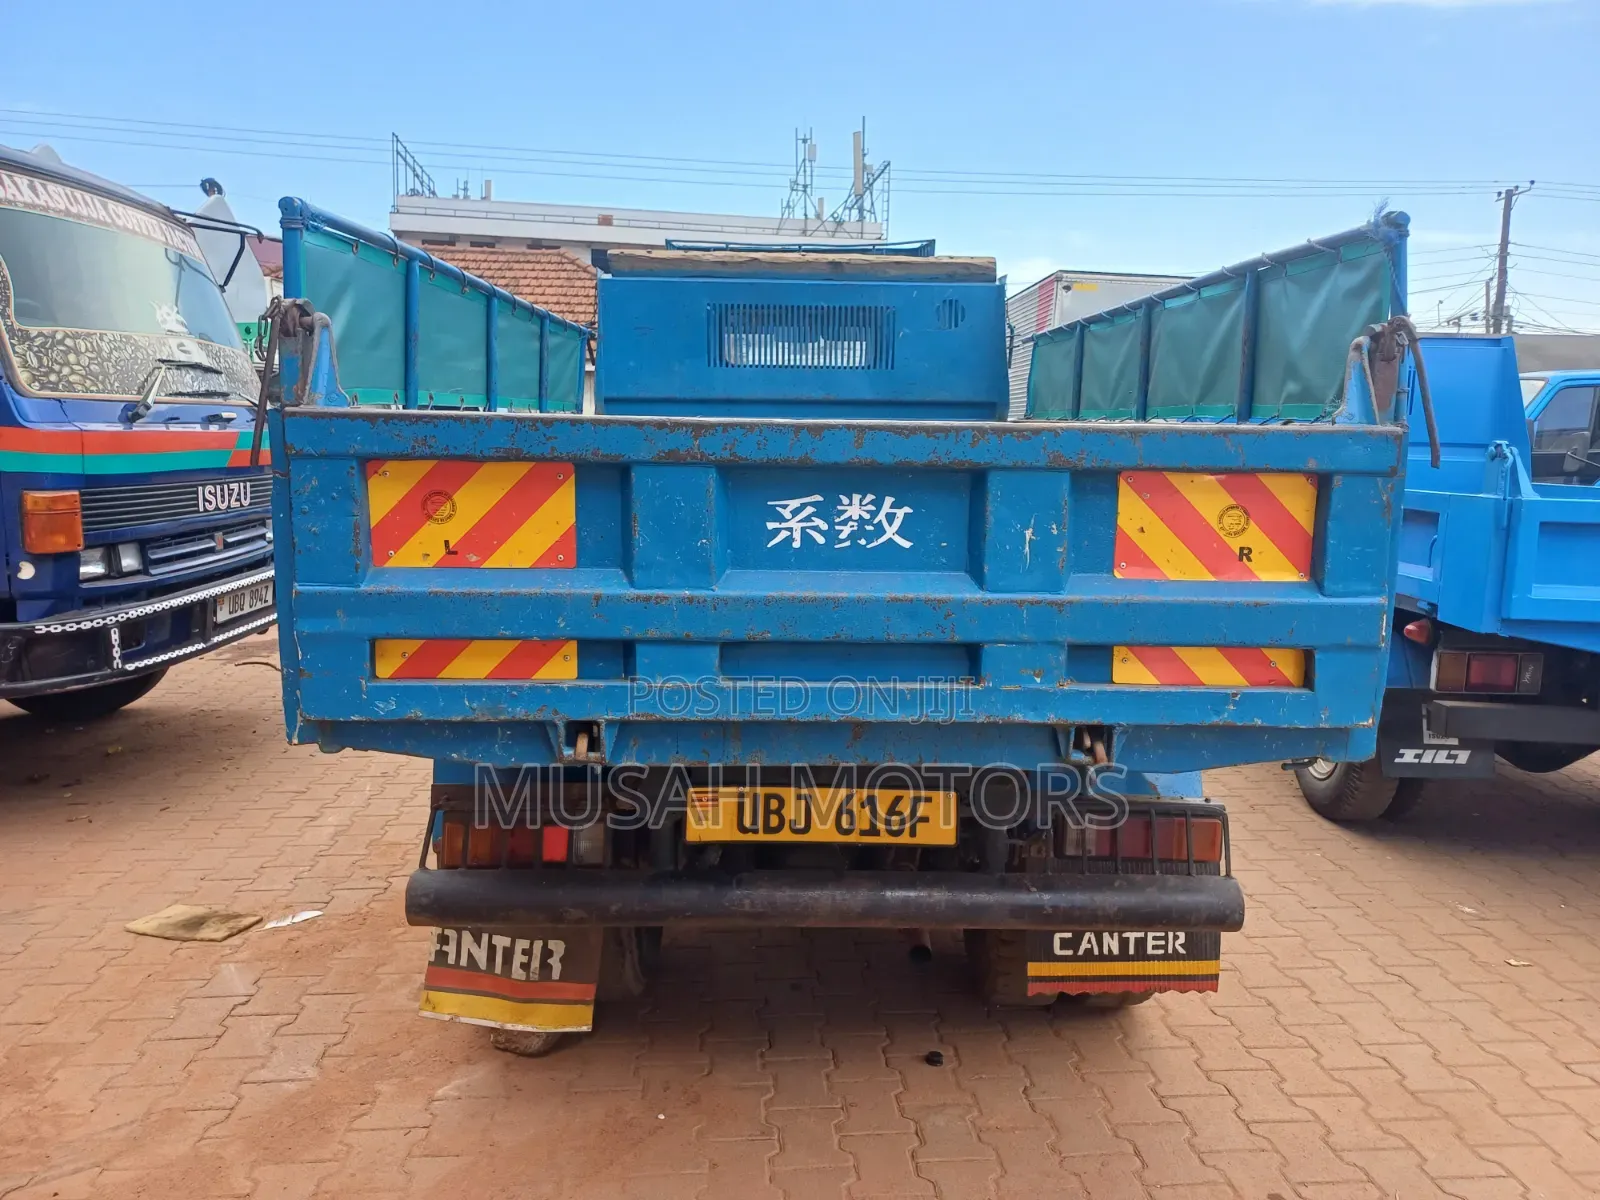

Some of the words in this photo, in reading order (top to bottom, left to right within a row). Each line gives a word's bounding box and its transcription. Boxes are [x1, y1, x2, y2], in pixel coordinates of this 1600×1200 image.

[198, 482, 251, 512] ISUZU
[443, 539, 459, 556] L
[1238, 546, 1253, 563] R
[228, 592, 246, 616] UBQ
[249, 585, 269, 607] 894Z
[736, 791, 812, 835] UBJ
[834, 794, 933, 838] 616F
[1053, 931, 1187, 956] CANTER
